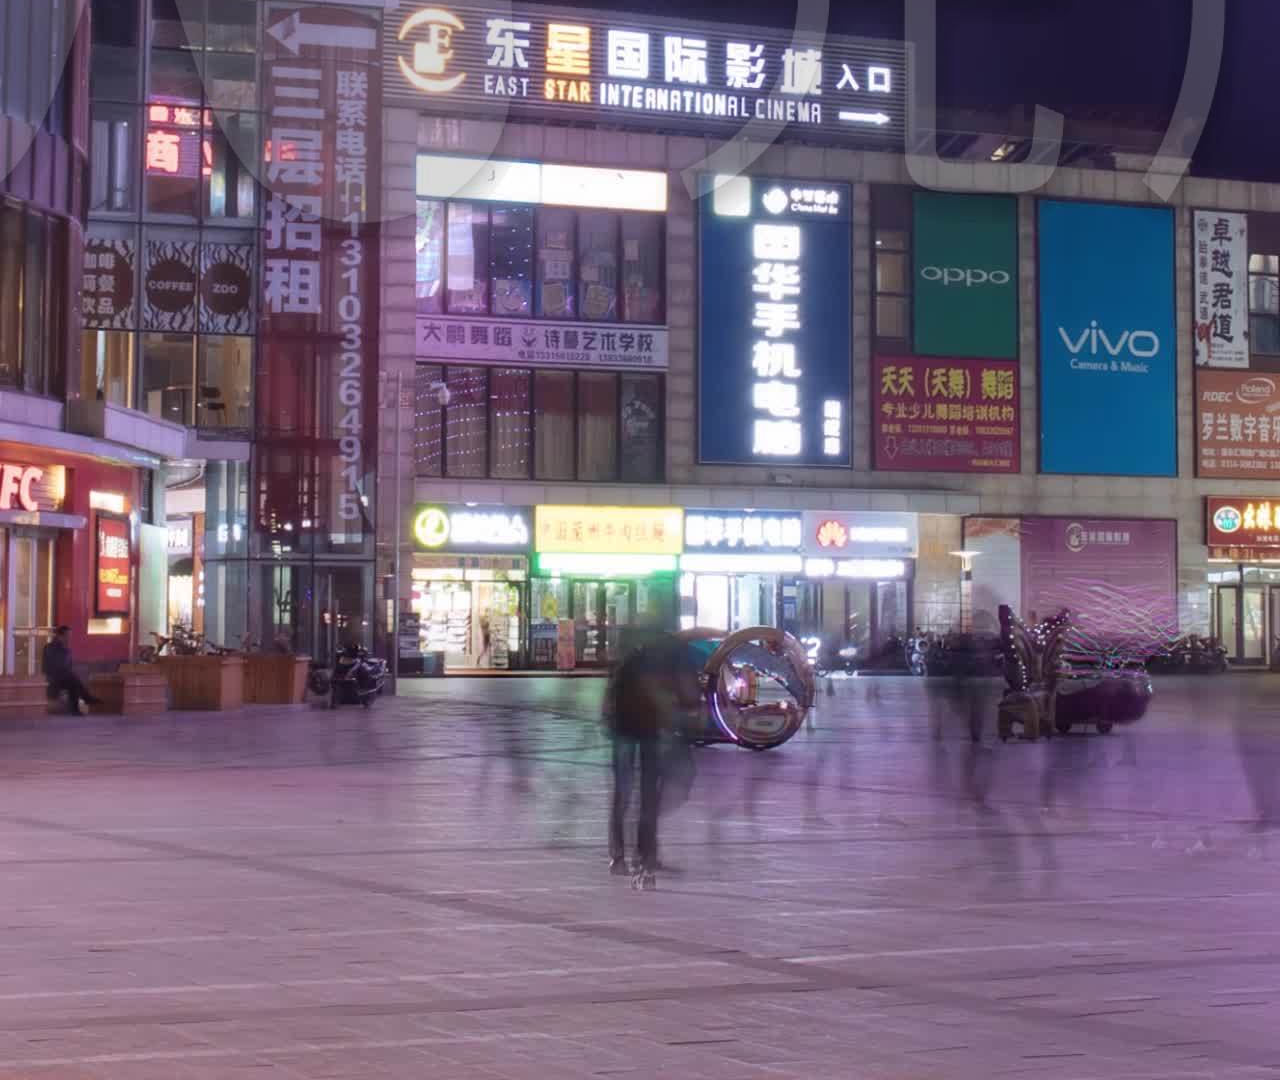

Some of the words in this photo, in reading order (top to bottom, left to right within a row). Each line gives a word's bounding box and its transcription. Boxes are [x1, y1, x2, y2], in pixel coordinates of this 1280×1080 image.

[485, 18, 822, 95] 东星国际影城
[836, 64, 891, 93] 入口
[484, 74, 531, 97] EAST
[544, 81, 591, 103] STAR
[600, 84, 750, 118] INTERNATIONAL
[755, 100, 822, 124] CINEMA
[148, 281, 193, 292] COFFEE
[212, 283, 238, 295] ZOO
[1070, 358, 1109, 372] Camera
[1120, 361, 1149, 374] Music
